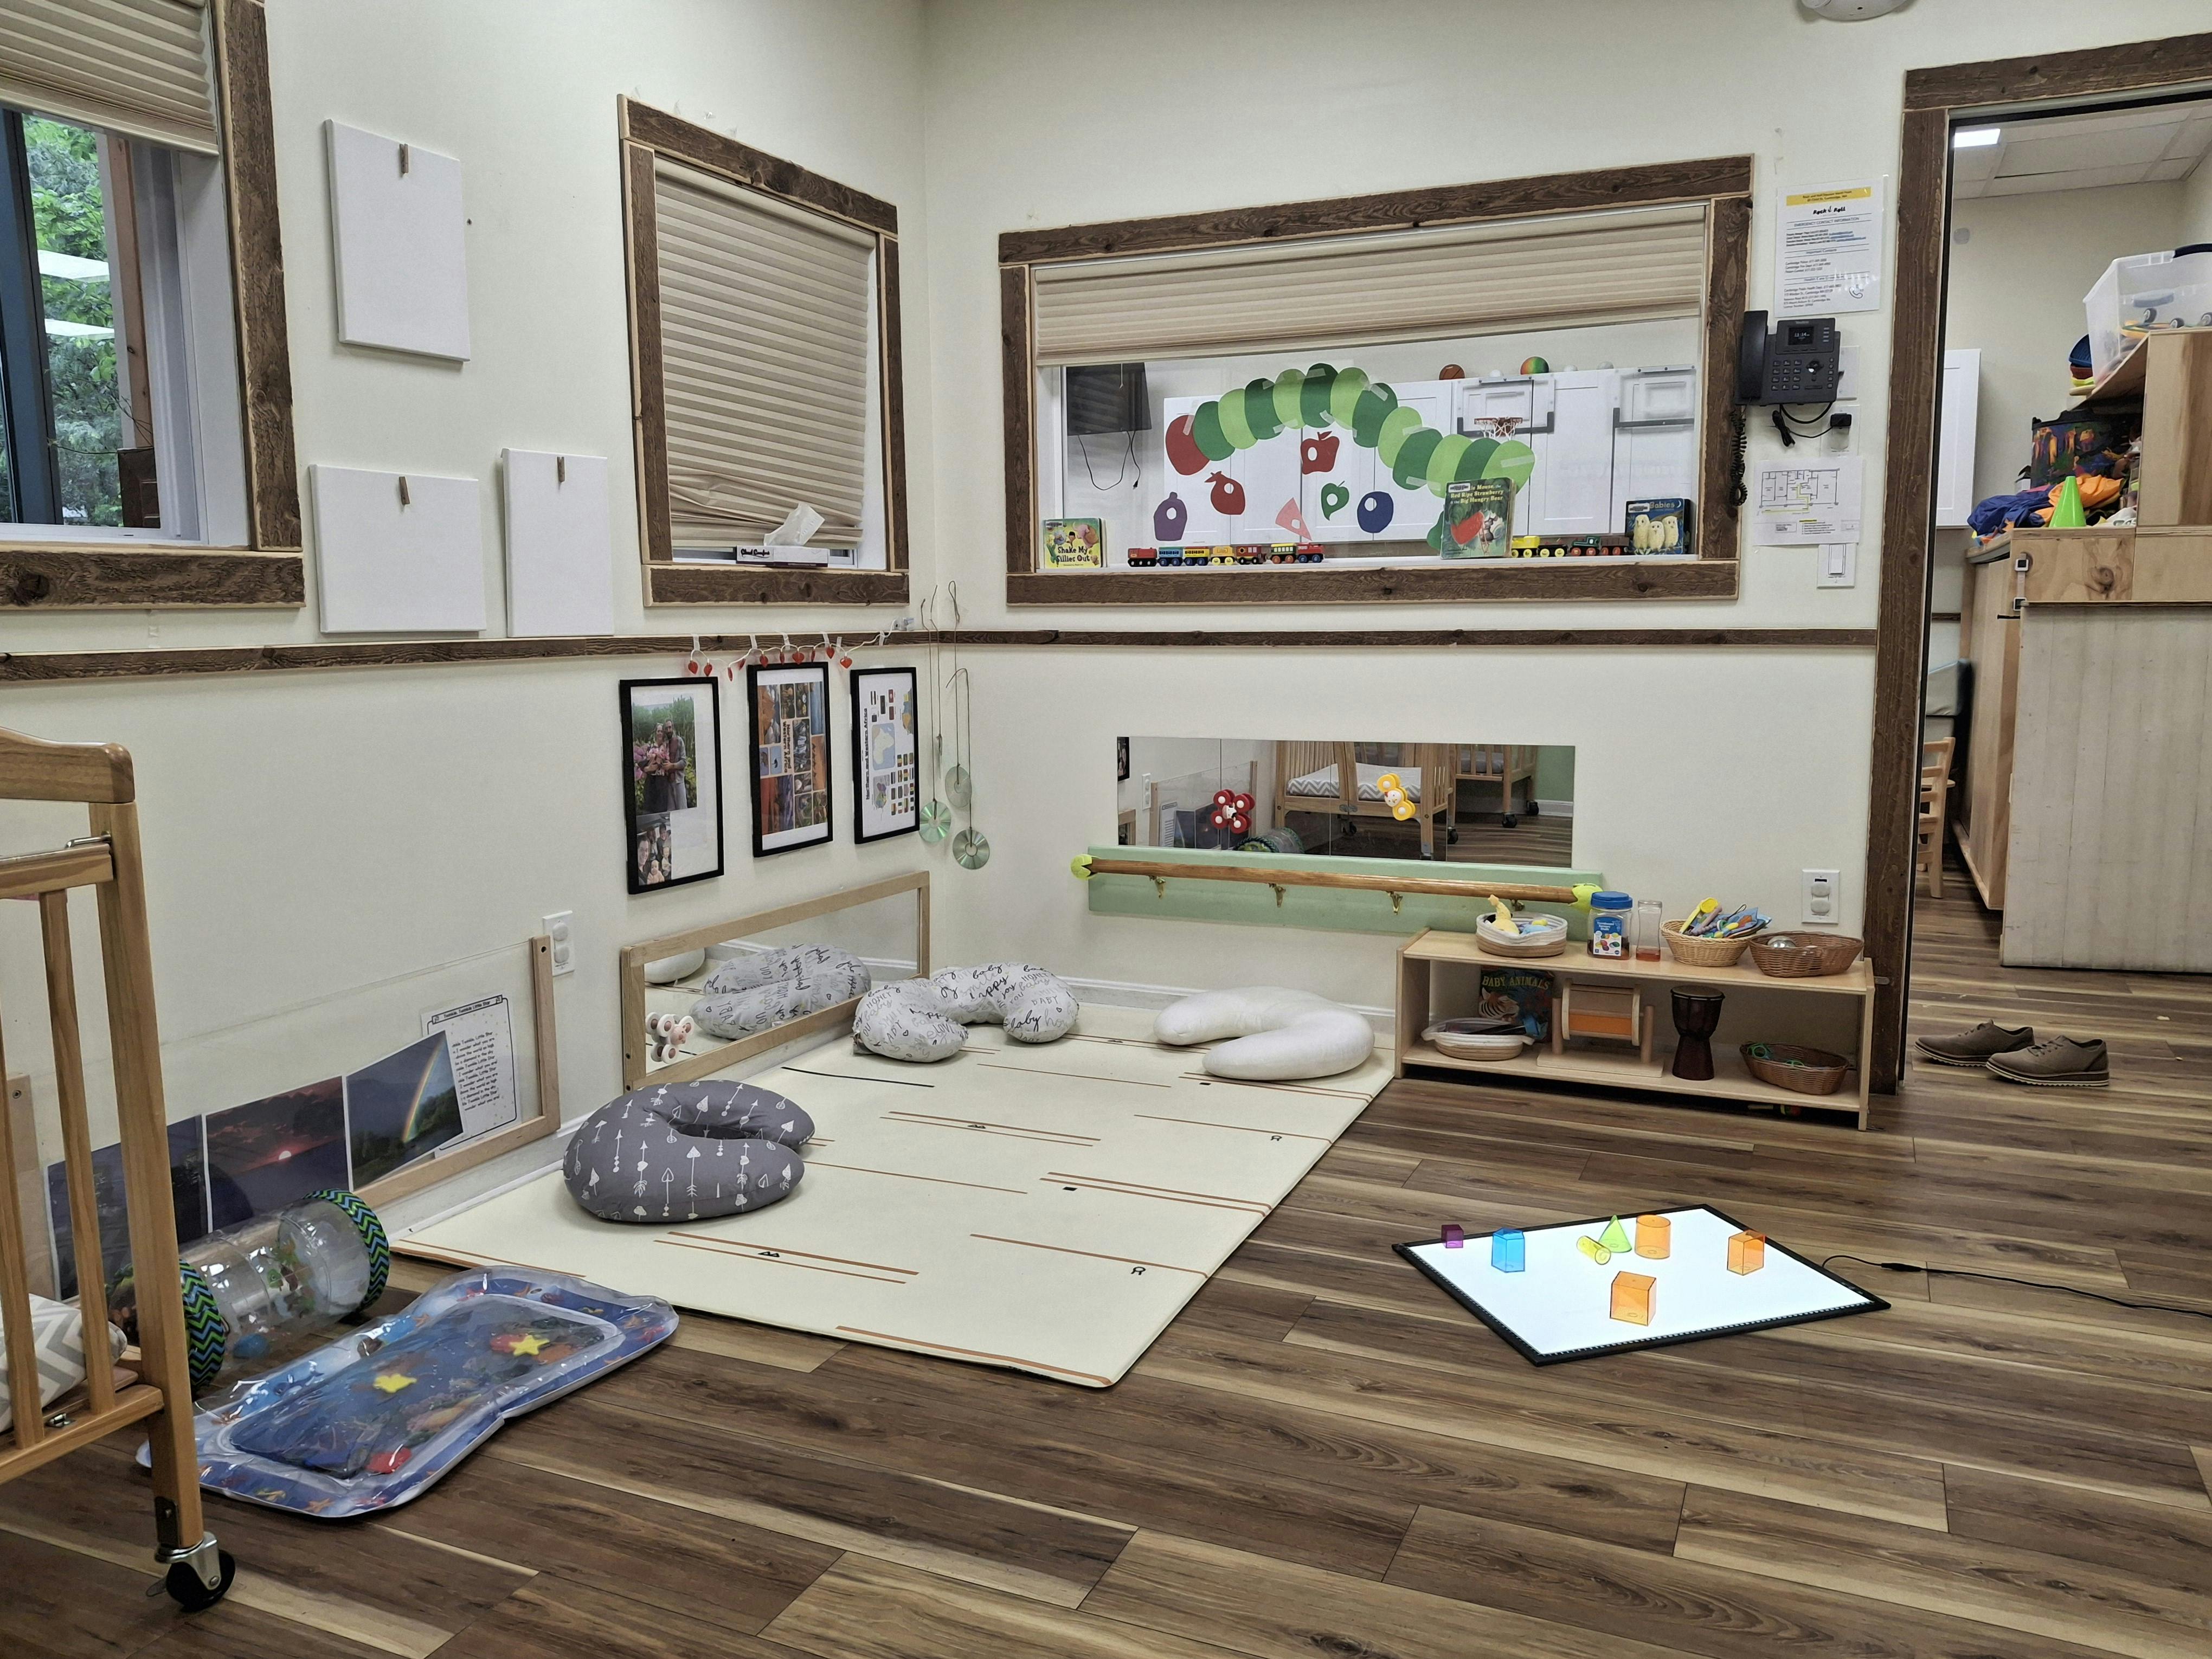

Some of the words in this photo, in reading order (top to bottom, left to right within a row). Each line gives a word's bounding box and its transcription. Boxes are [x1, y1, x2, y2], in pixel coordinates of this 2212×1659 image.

[1078, 546, 1088, 555] My
[973, 964, 1003, 980] baby
[1000, 982, 1017, 1000] joy
[1481, 975, 1506, 987] BABY
[1509, 976, 1551, 991] ANIMALS
[1031, 995, 1058, 1006] BABY
